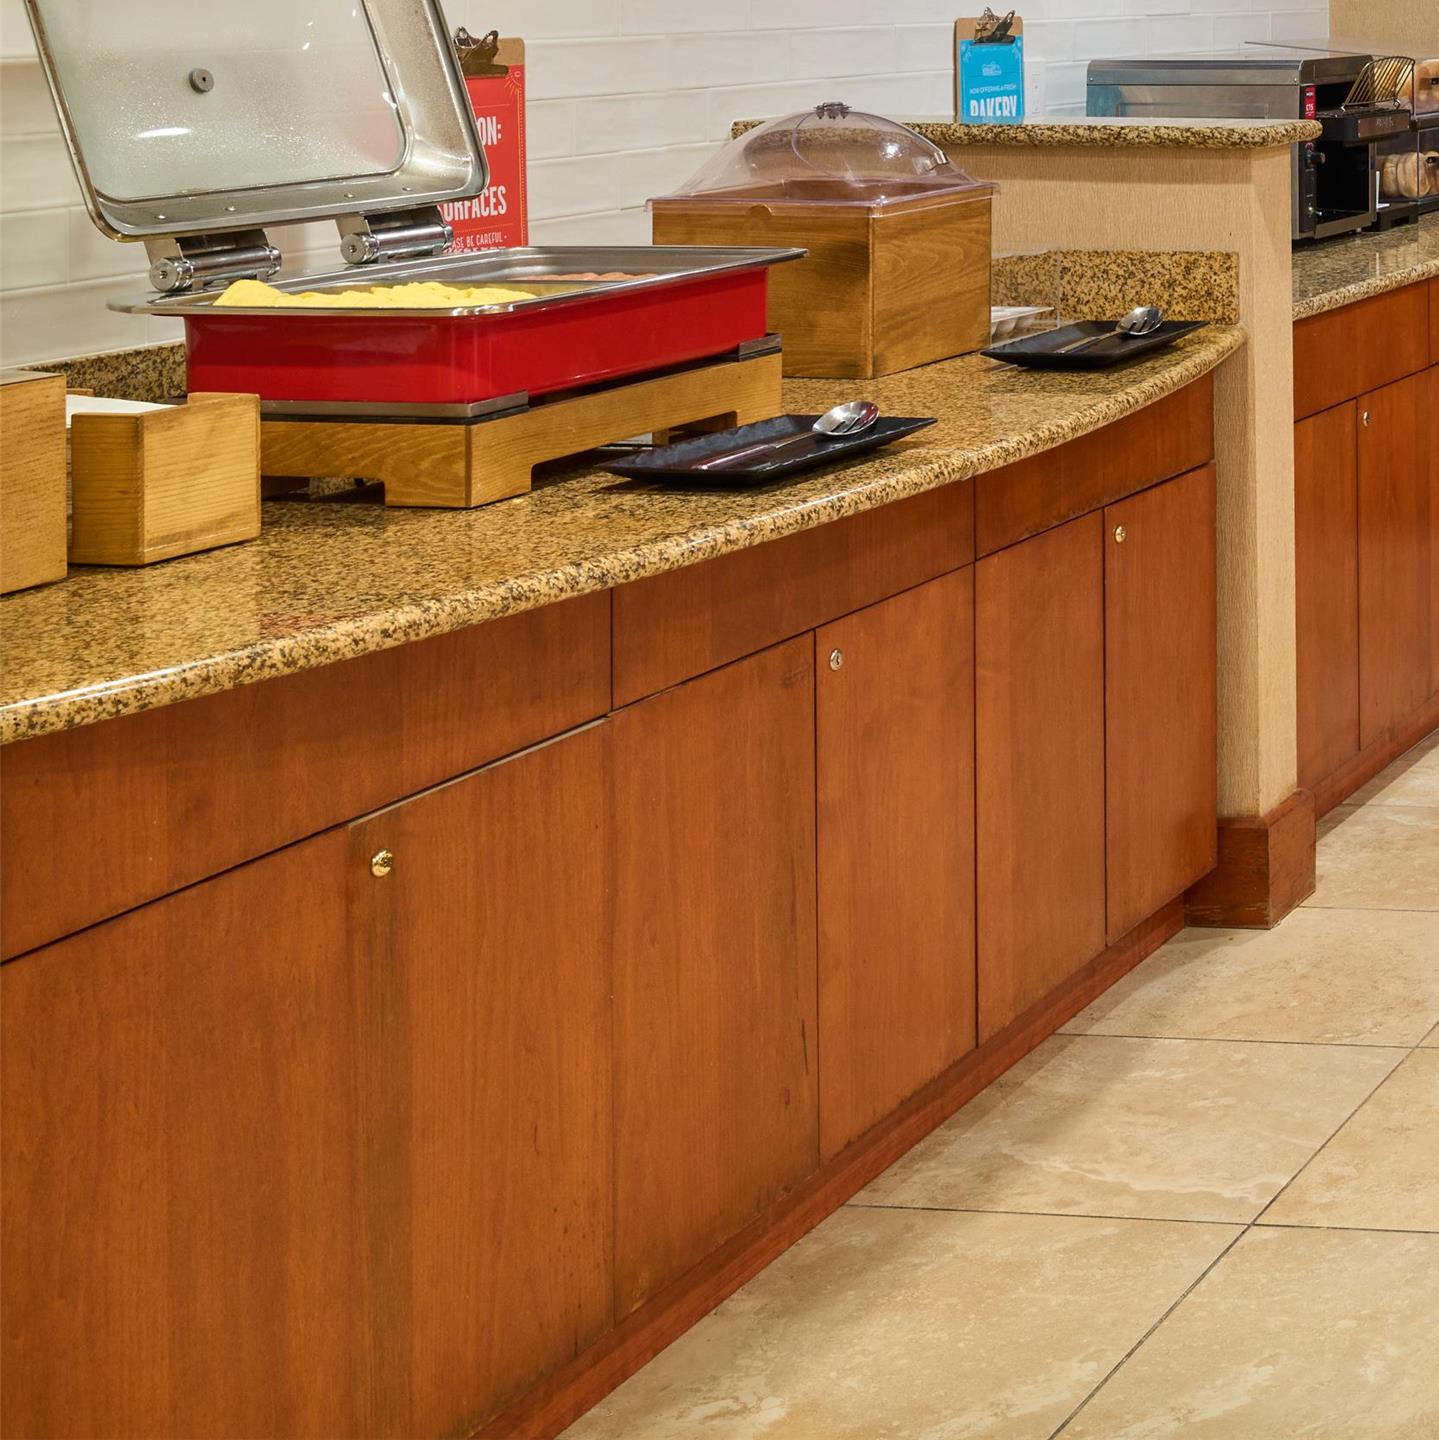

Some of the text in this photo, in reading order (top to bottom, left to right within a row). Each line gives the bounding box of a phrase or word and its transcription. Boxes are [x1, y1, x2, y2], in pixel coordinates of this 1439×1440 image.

[444, 185, 507, 222] URFACES
[466, 235, 474, 248] BE
[476, 232, 503, 246] CAREFUL
